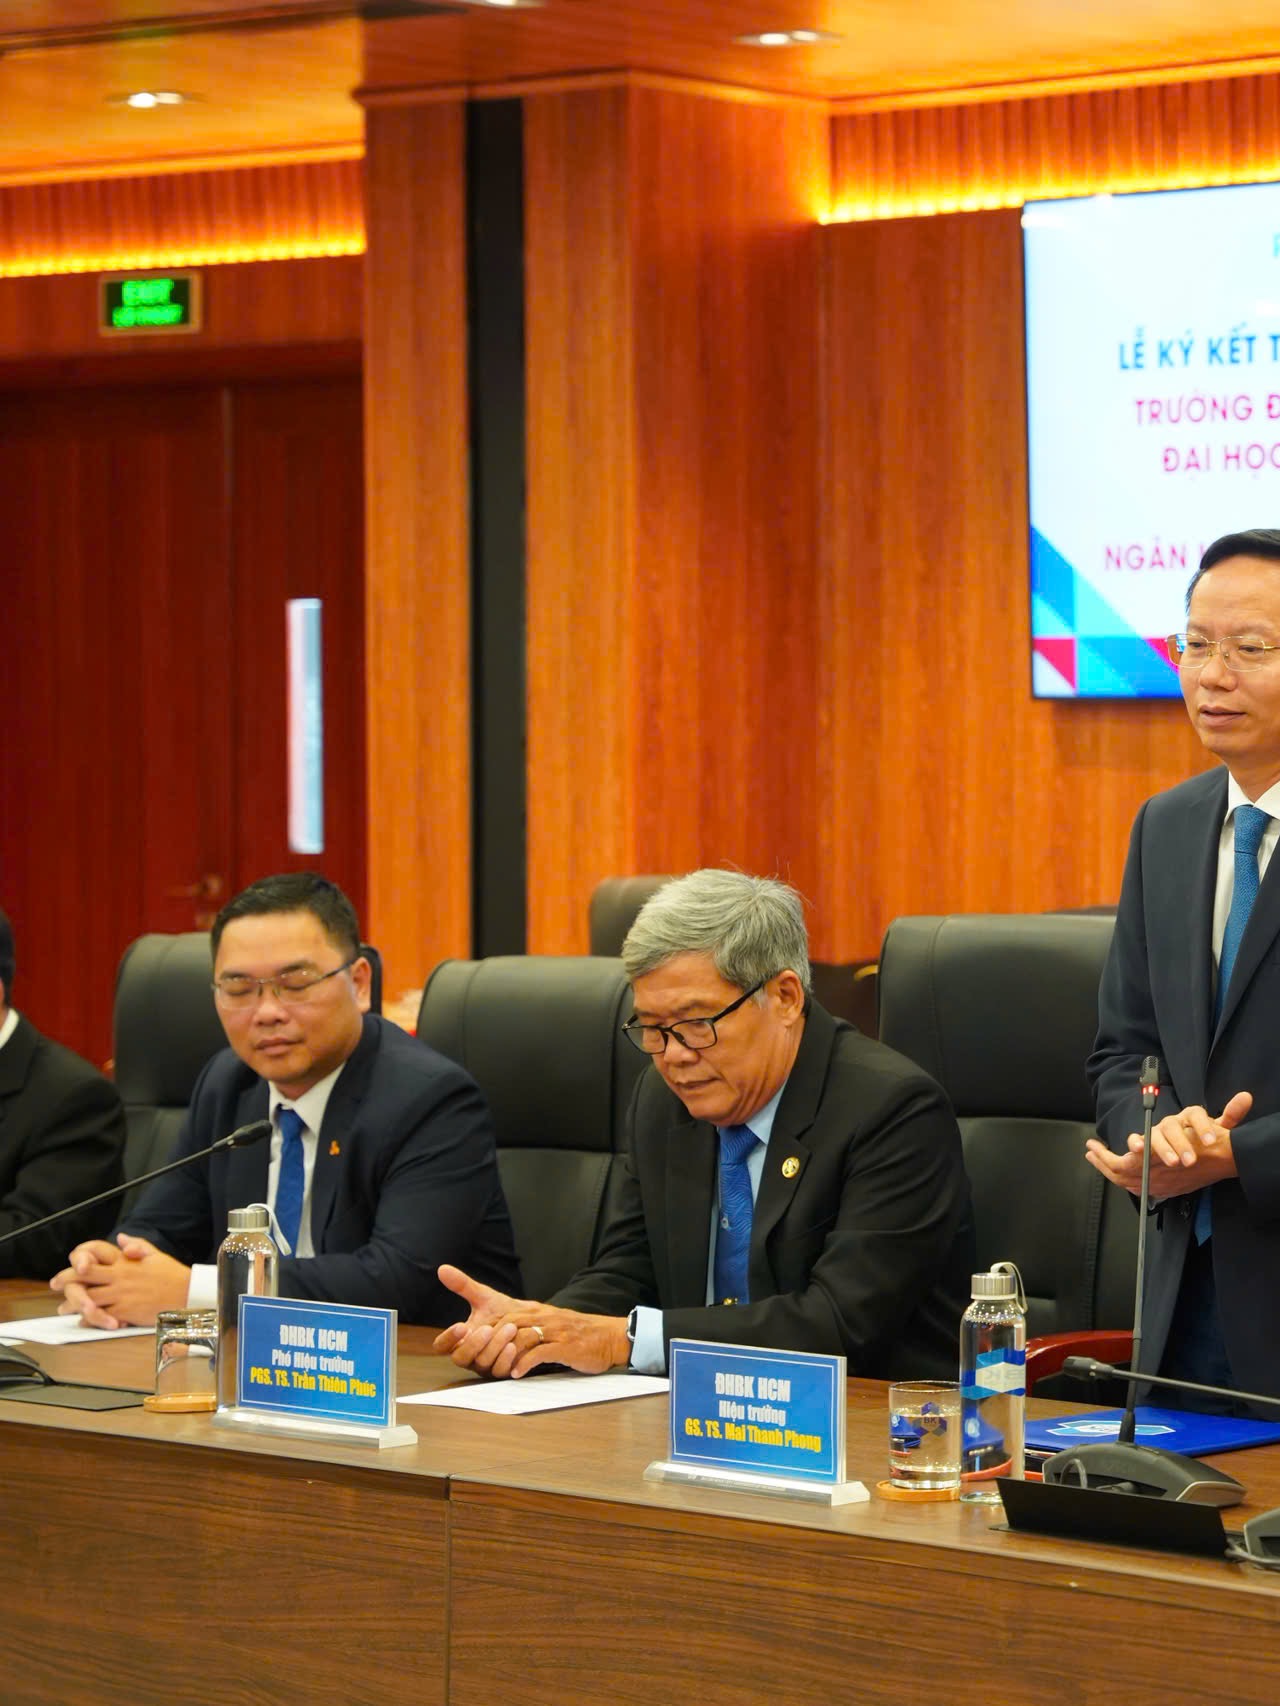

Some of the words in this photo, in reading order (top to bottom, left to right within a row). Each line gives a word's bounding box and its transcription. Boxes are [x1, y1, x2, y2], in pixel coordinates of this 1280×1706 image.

[1157, 328, 1194, 368] KÝ
[1208, 321, 1257, 365] KẾT
[1163, 445, 1211, 480] ĐẠI
[1104, 535, 1187, 571] NGÂN
[280, 1324, 315, 1349] ĐHBK
[319, 1328, 348, 1352] HCM
[272, 1349, 291, 1367] Phó
[294, 1352, 317, 1372] Hiệu
[250, 1367, 273, 1385] PGS.
[275, 1369, 290, 1387] TS.
[292, 1370, 316, 1390] Trần
[350, 1380, 376, 1398] Phúc
[715, 1373, 754, 1399] ĐHBK
[758, 1376, 791, 1402] HCM
[718, 1400, 744, 1422] Hiệu
[923, 1416, 937, 1424] BK
[685, 1418, 703, 1437] GS.
[705, 1420, 722, 1439] TS.
[725, 1423, 746, 1442] Mai
[748, 1425, 783, 1446] Thanh
[785, 1429, 822, 1453] Phong
